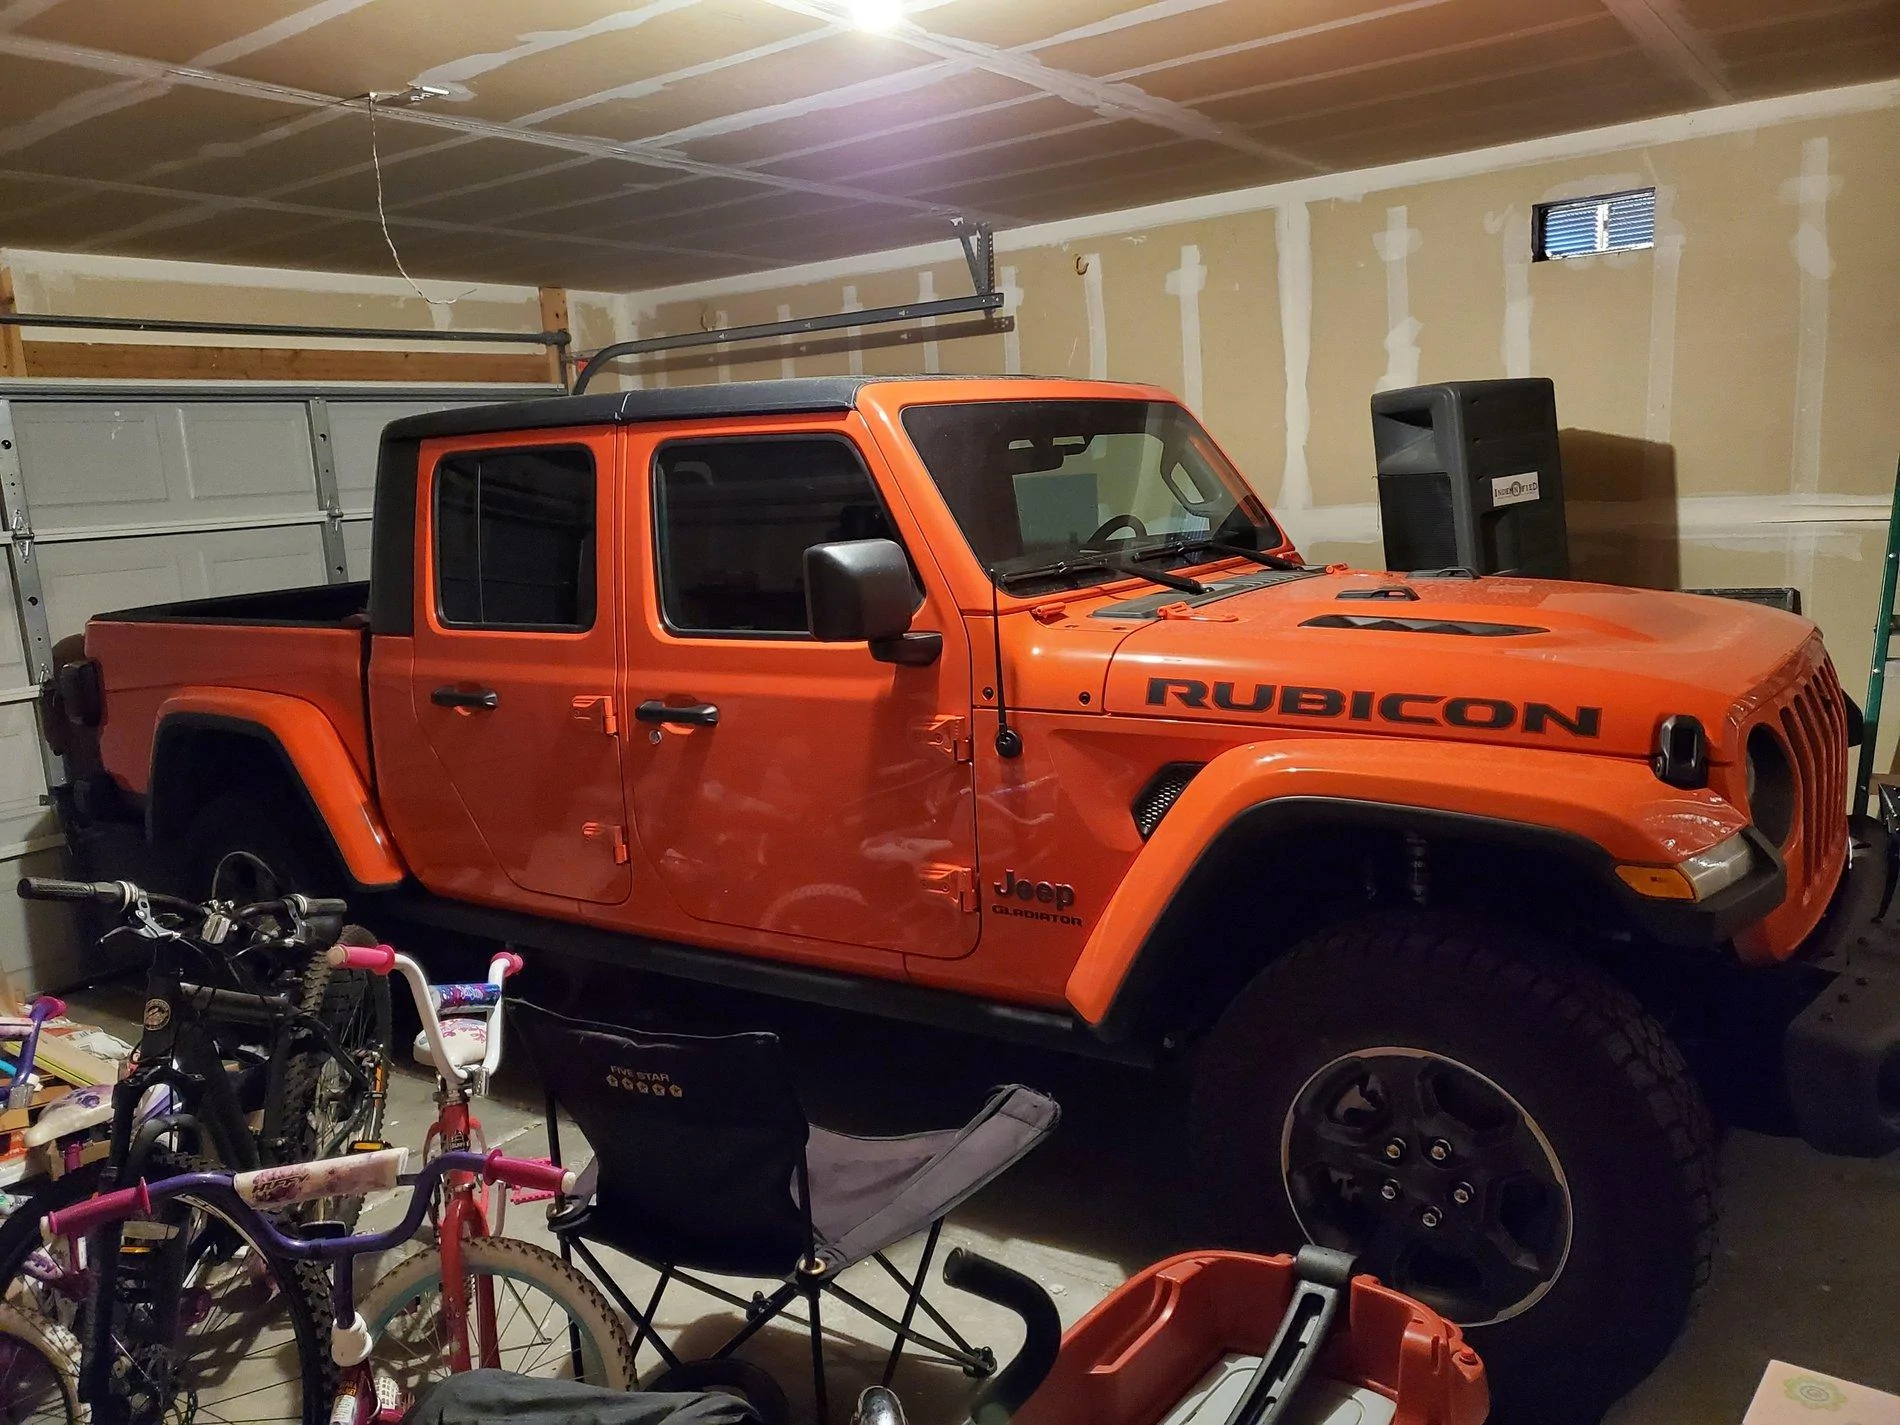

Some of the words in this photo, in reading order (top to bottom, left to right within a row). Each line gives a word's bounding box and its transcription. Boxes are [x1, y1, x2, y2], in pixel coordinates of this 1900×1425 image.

[1144, 677, 1602, 739] RUBICON
[993, 868, 1075, 911] Jeep
[991, 904, 1083, 927] GLADIATOR
[610, 1065, 634, 1078] FIVE
[636, 1071, 670, 1082] STAR
